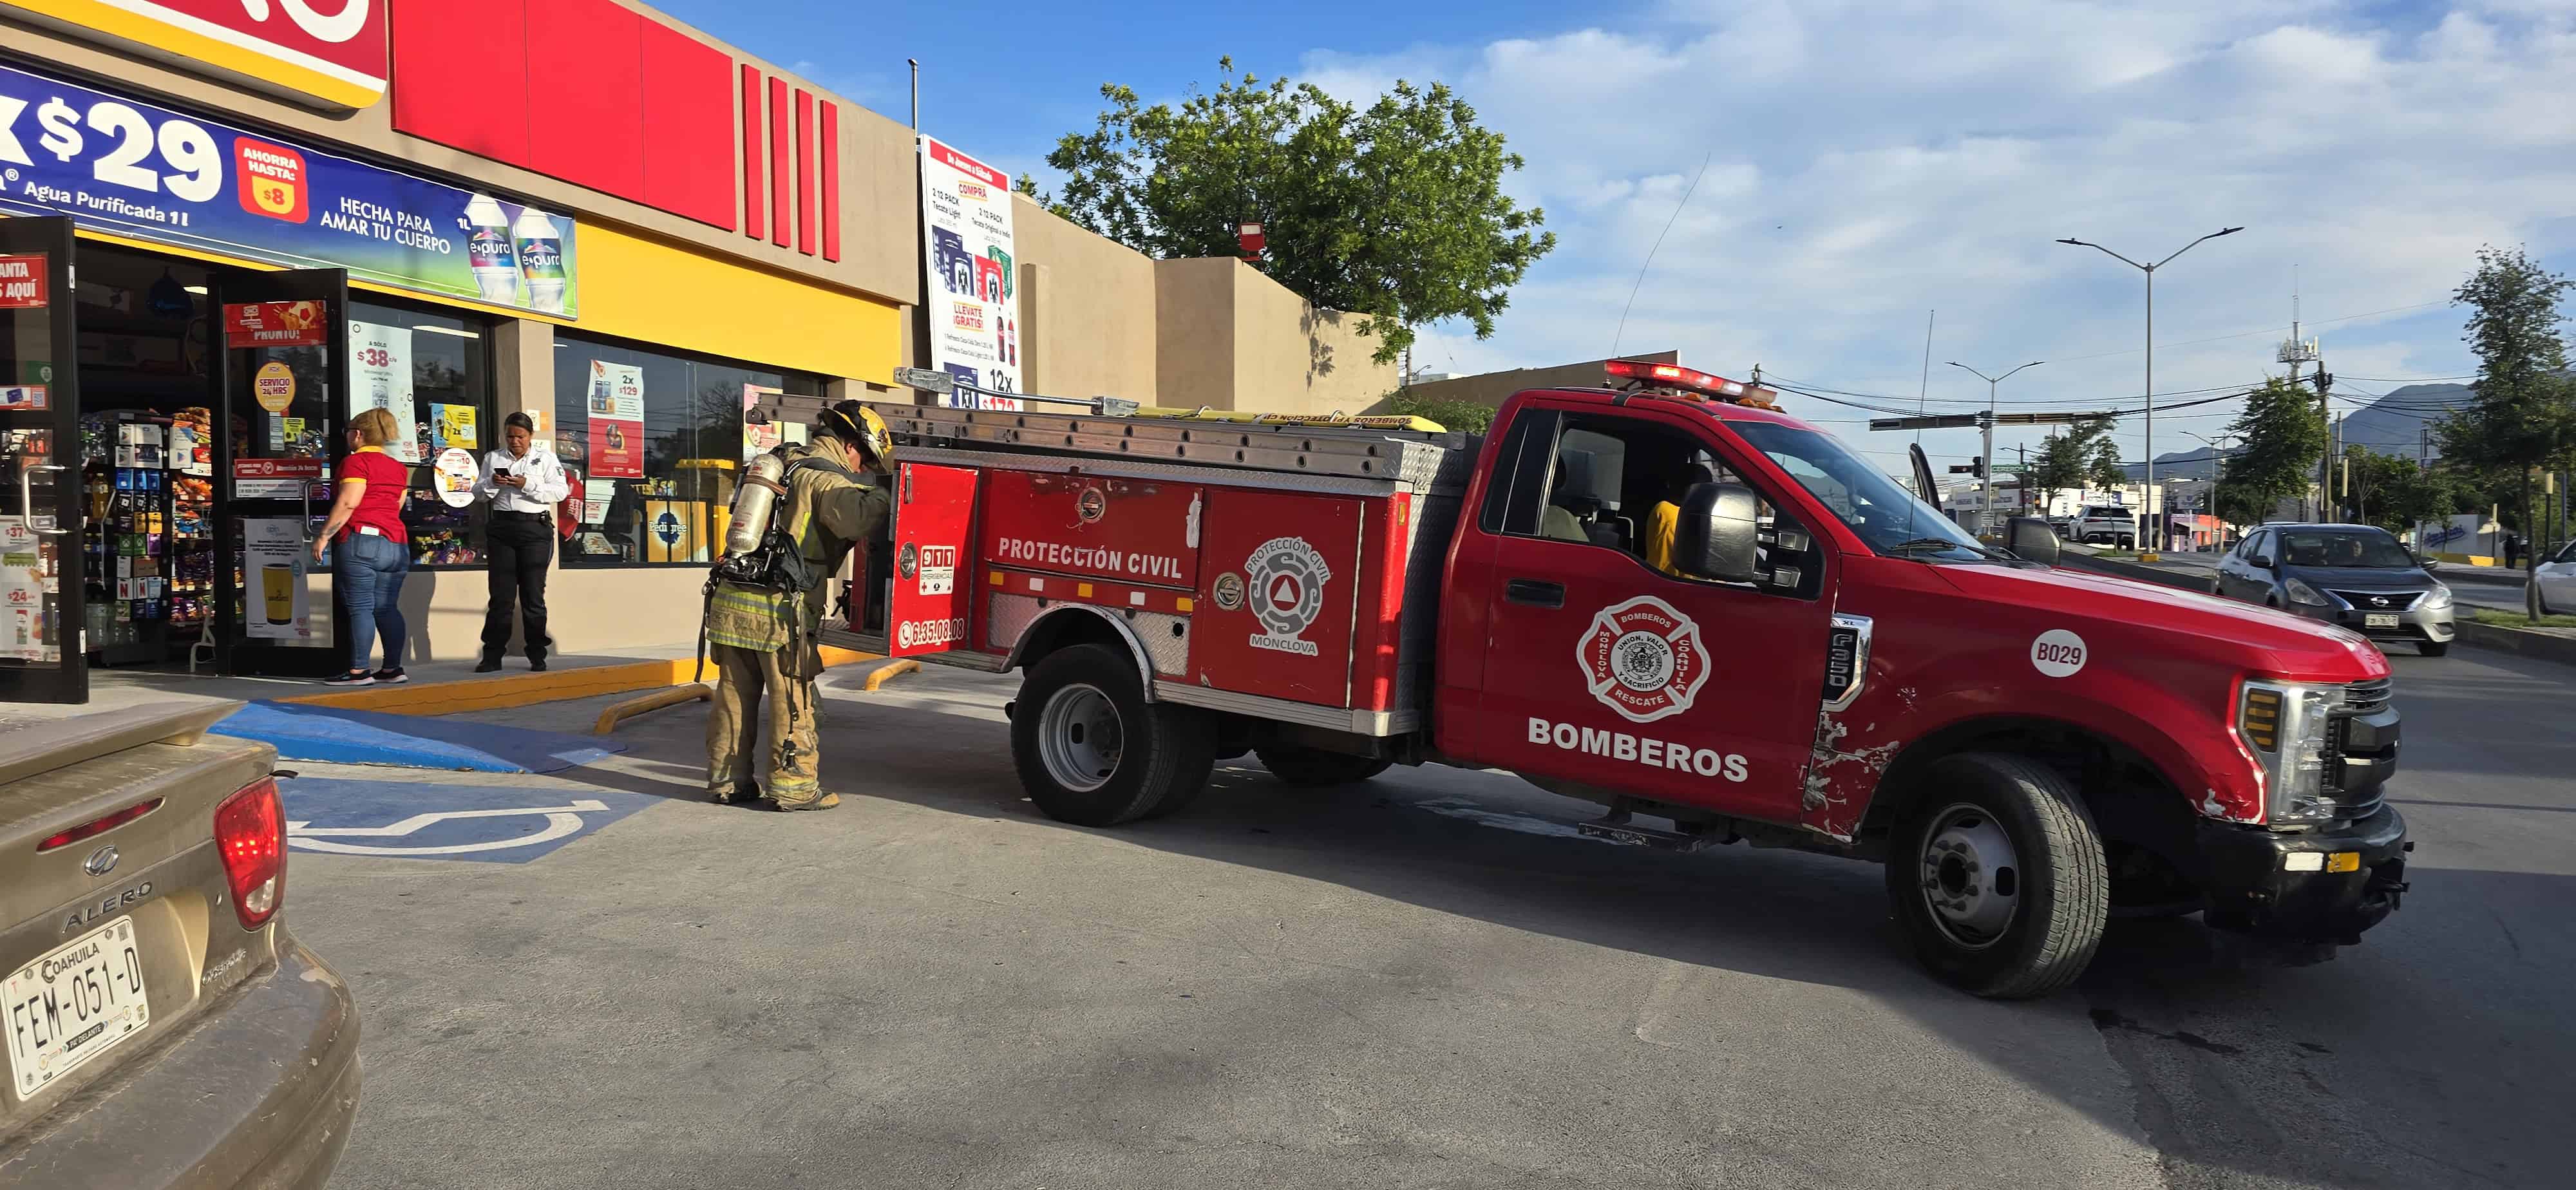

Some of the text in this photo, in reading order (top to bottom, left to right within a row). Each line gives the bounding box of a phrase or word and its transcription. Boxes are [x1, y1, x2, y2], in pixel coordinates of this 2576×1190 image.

[37, 97, 222, 202] $29
[243, 148, 298, 170] AHORRA
[249, 161, 296, 181] HASTA:
[263, 188, 285, 205] $8
[933, 188, 936, 196] 2
[945, 193, 960, 206] PACK
[958, 184, 988, 198] COMPRA
[24, 181, 71, 202] Agua
[77, 191, 166, 222] Purificada
[341, 197, 433, 234] HECHA PARA
[990, 212, 1003, 224] PACK
[321, 211, 451, 254] AMAR TU CUERPO
[6, 278, 37, 301] AQUÍ
[357, 348, 389, 367] $38
[259, 378, 290, 387] SERVICIO
[622, 375, 634, 385] 2x
[990, 369, 1013, 393] 12x
[273, 386, 287, 395] HRS
[619, 386, 638, 396] $129
[923, 551, 951, 565] 911
[999, 536, 1182, 578] PROTECCIÓN CIVIL
[1246, 538, 1329, 583] PROTECCIÓN CIVIL
[1621, 612, 1672, 628] BOMBEROS
[1251, 635, 1316, 654] MONCLOVA
[1597, 631, 1610, 678] MONCLOVA
[1647, 636, 1669, 656] VALOR
[1675, 639, 1690, 690] COAHUILA
[1623, 676, 1664, 689] SACRIFICIO
[1615, 689, 1665, 706] RESCATE
[1528, 716, 1748, 783] BOMBEROS
[62, 880, 152, 934] ALERO
[41, 942, 100, 984] COAHUILA
[13, 947, 140, 1058] FEM-051-D
[78, 1025, 102, 1042] DELANTE
